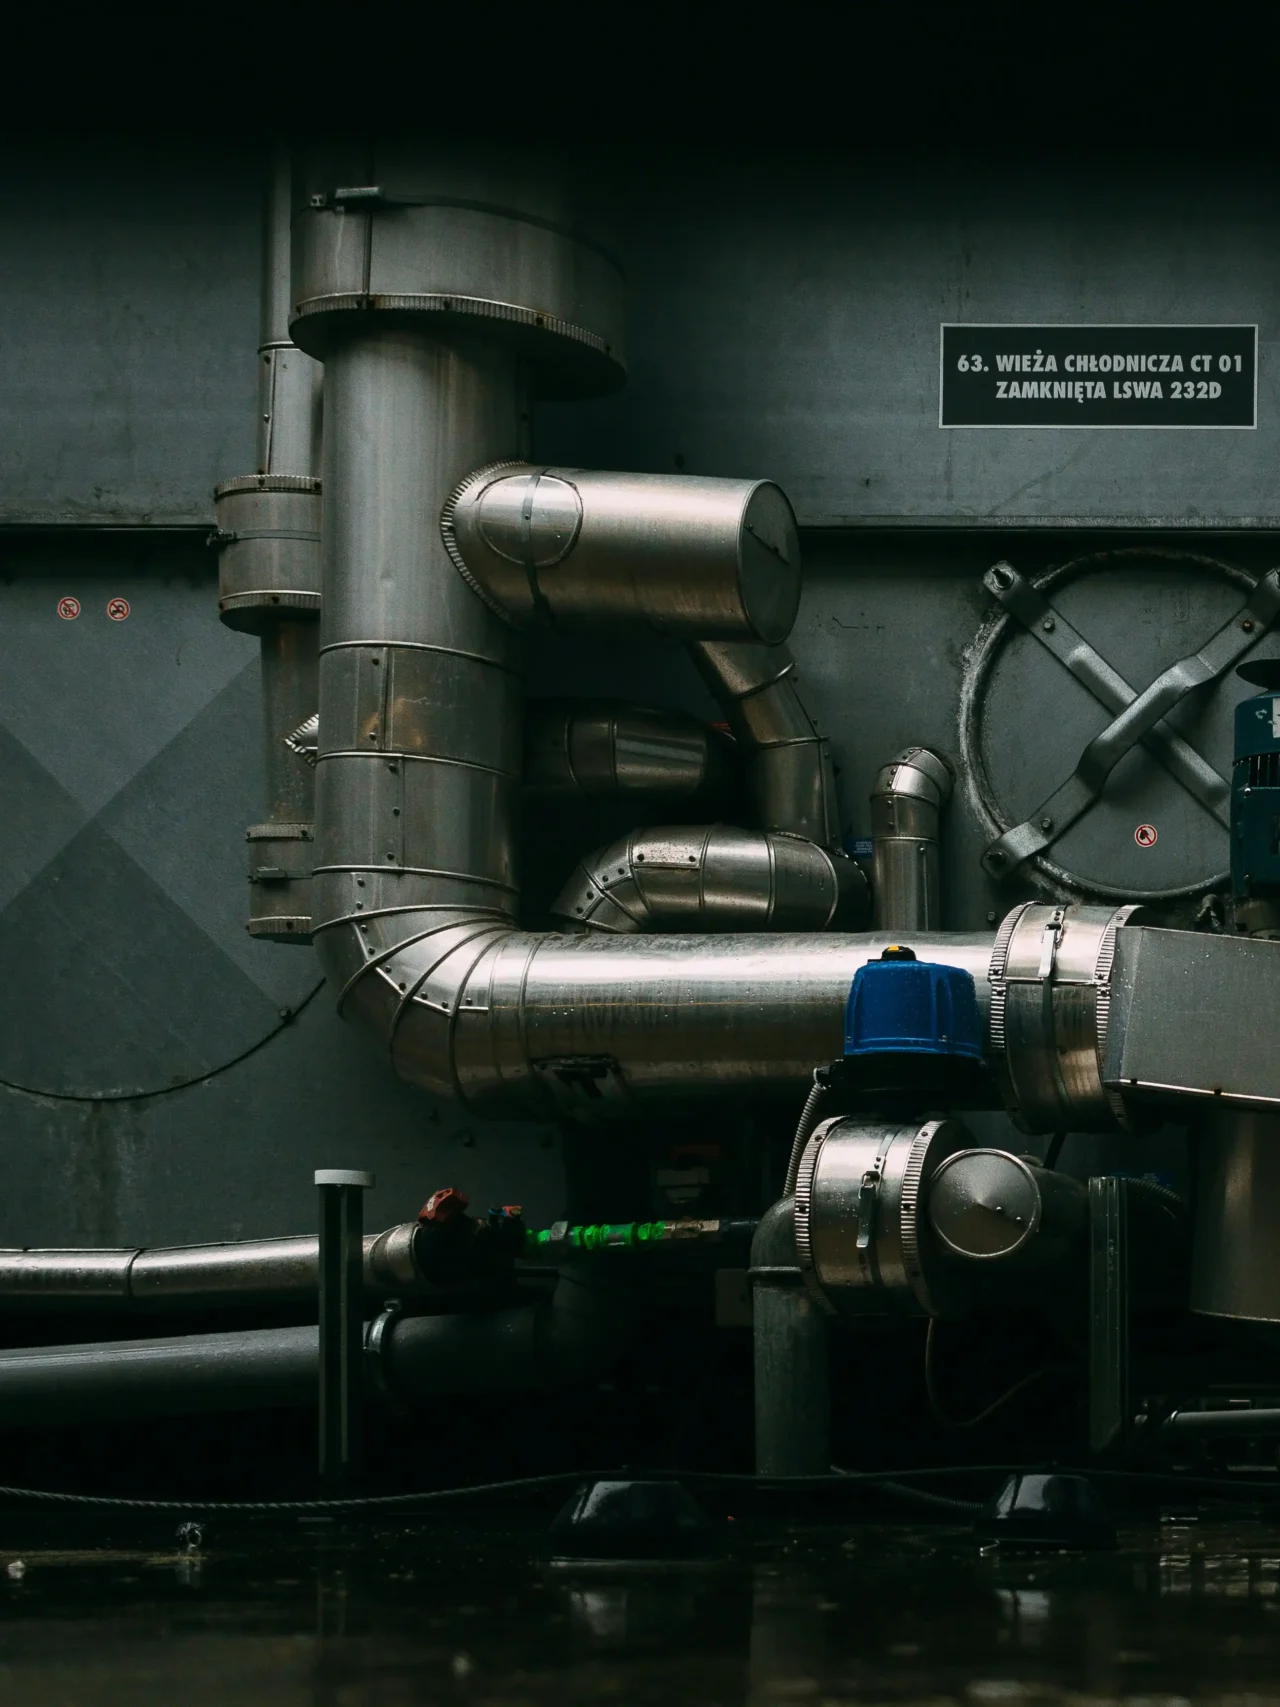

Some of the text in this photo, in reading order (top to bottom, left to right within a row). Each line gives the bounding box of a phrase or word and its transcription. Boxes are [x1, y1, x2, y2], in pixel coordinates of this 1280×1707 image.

[957, 349, 1242, 372] 63. WIEŻA CHŁODNICZA CT 01
[995, 381, 1222, 403] ZAMKNIĘTA LSWA 232D
